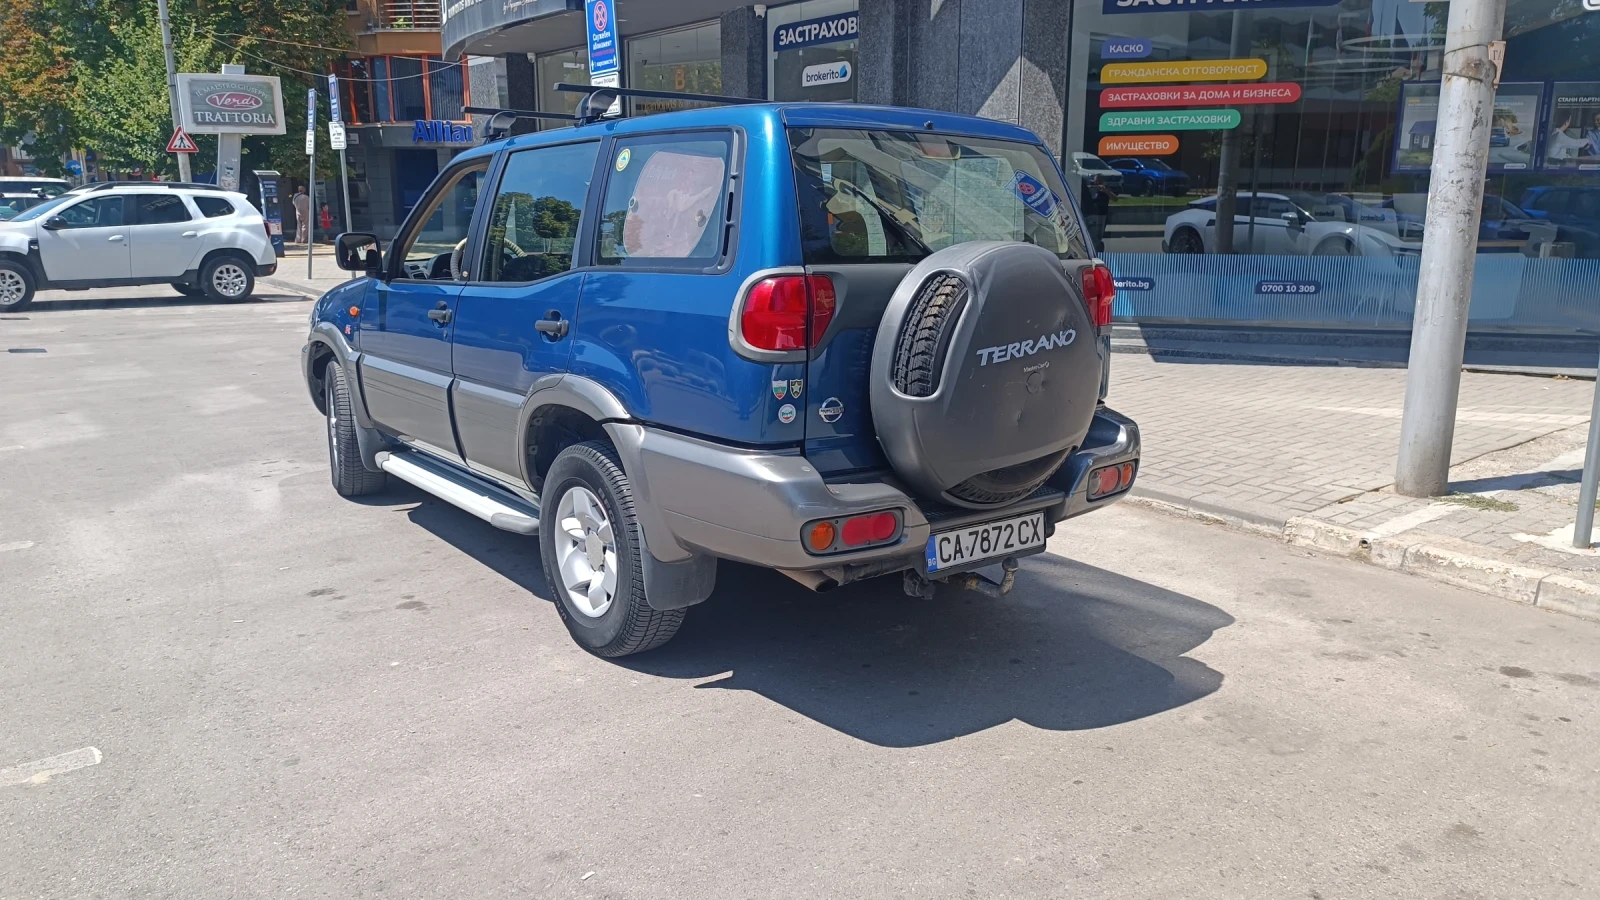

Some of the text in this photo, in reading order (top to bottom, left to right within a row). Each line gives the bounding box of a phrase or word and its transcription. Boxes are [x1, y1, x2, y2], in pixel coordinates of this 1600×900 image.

[779, 16, 859, 46] ЗАСТРАХОВ
[1109, 44, 1144, 53] КАСКО
[806, 69, 840, 83] brokerito
[1109, 64, 1259, 78] ГРАЖДАНСКА ОТГОВОРНОСТ
[203, 83, 237, 94] MAESTRO
[1108, 88, 1292, 102] ЗАСТРАХОВКИ ЗА ДОМА И БИЗНЕСА
[211, 92, 257, 108] Verdi
[194, 111, 275, 124] TRATTORIA
[1107, 115, 1231, 127] ЗДРАВНИ ЗАСТРАХОВКИ
[1106, 141, 1170, 151] ИМУЩЕСТВО
[1261, 285, 1316, 293] 0700 10 309
[975, 328, 1077, 367] TERRANO
[939, 516, 1041, 564] CA 7872 CX
[927, 557, 937, 567] BG
